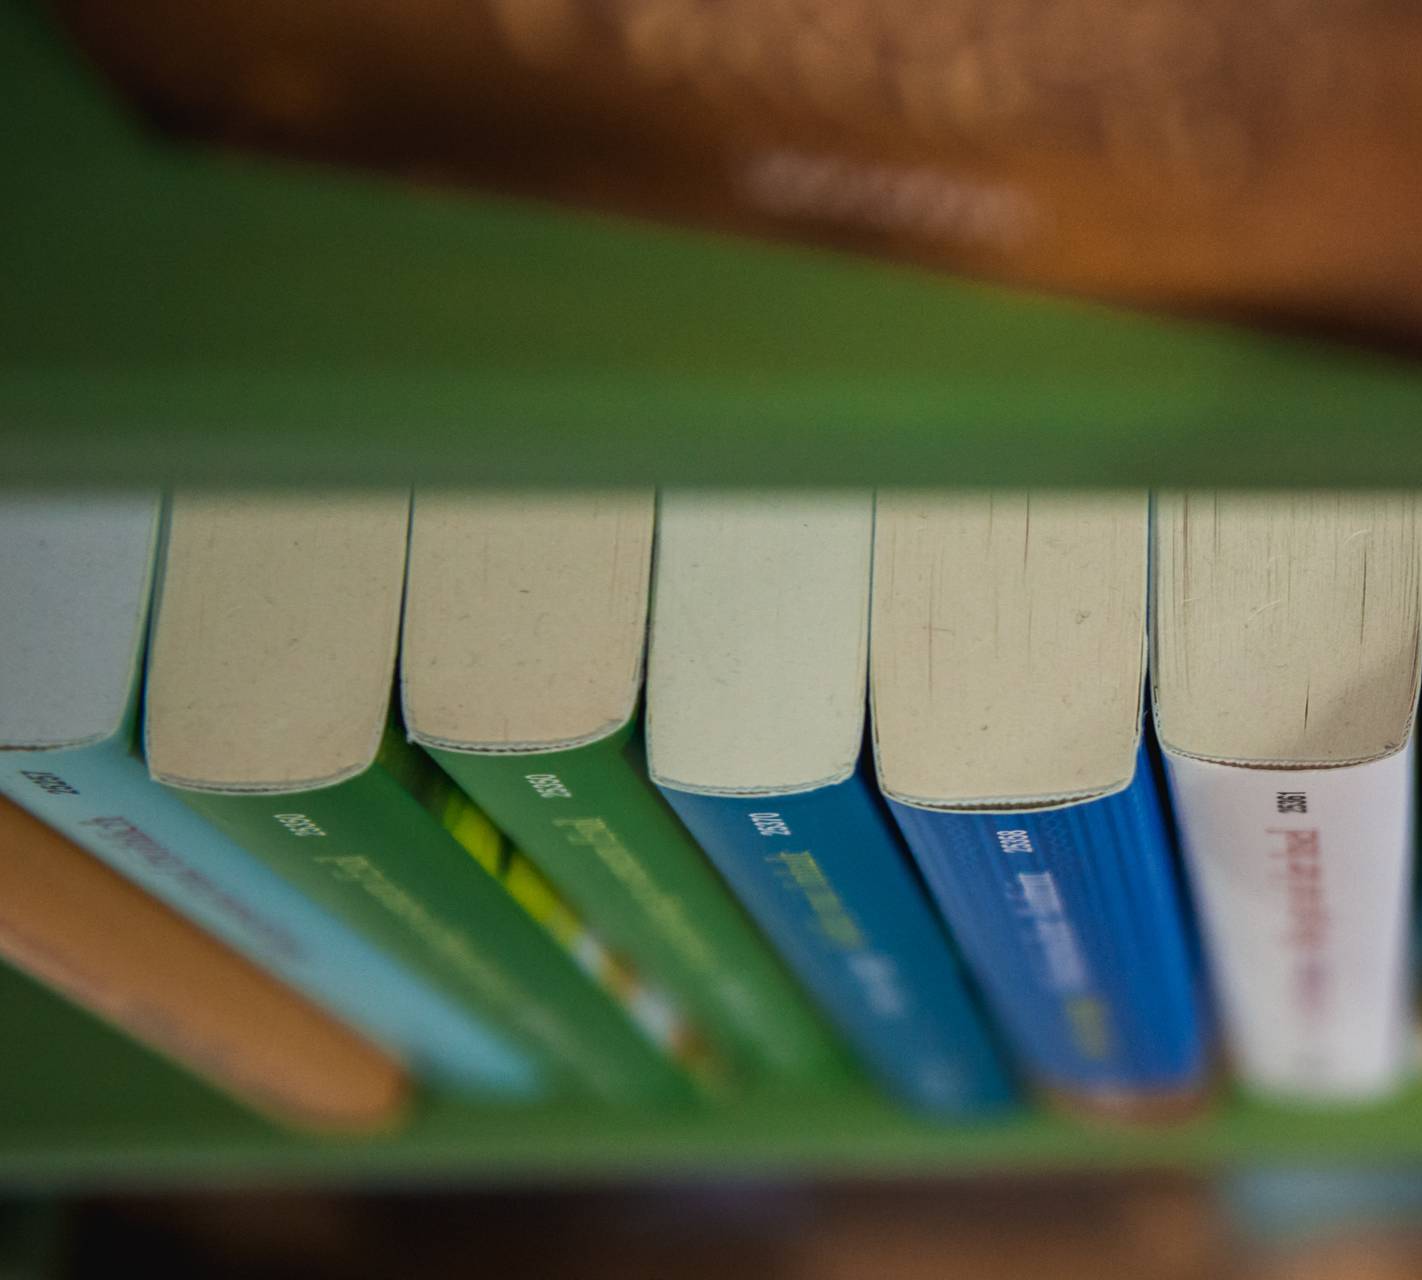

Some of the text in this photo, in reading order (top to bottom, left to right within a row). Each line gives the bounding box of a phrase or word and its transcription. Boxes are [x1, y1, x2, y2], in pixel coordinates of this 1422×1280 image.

[524, 774, 572, 798] 25350
[1276, 791, 1307, 814] 25361
[748, 812, 792, 836] 25370
[996, 829, 1034, 853] 25358
